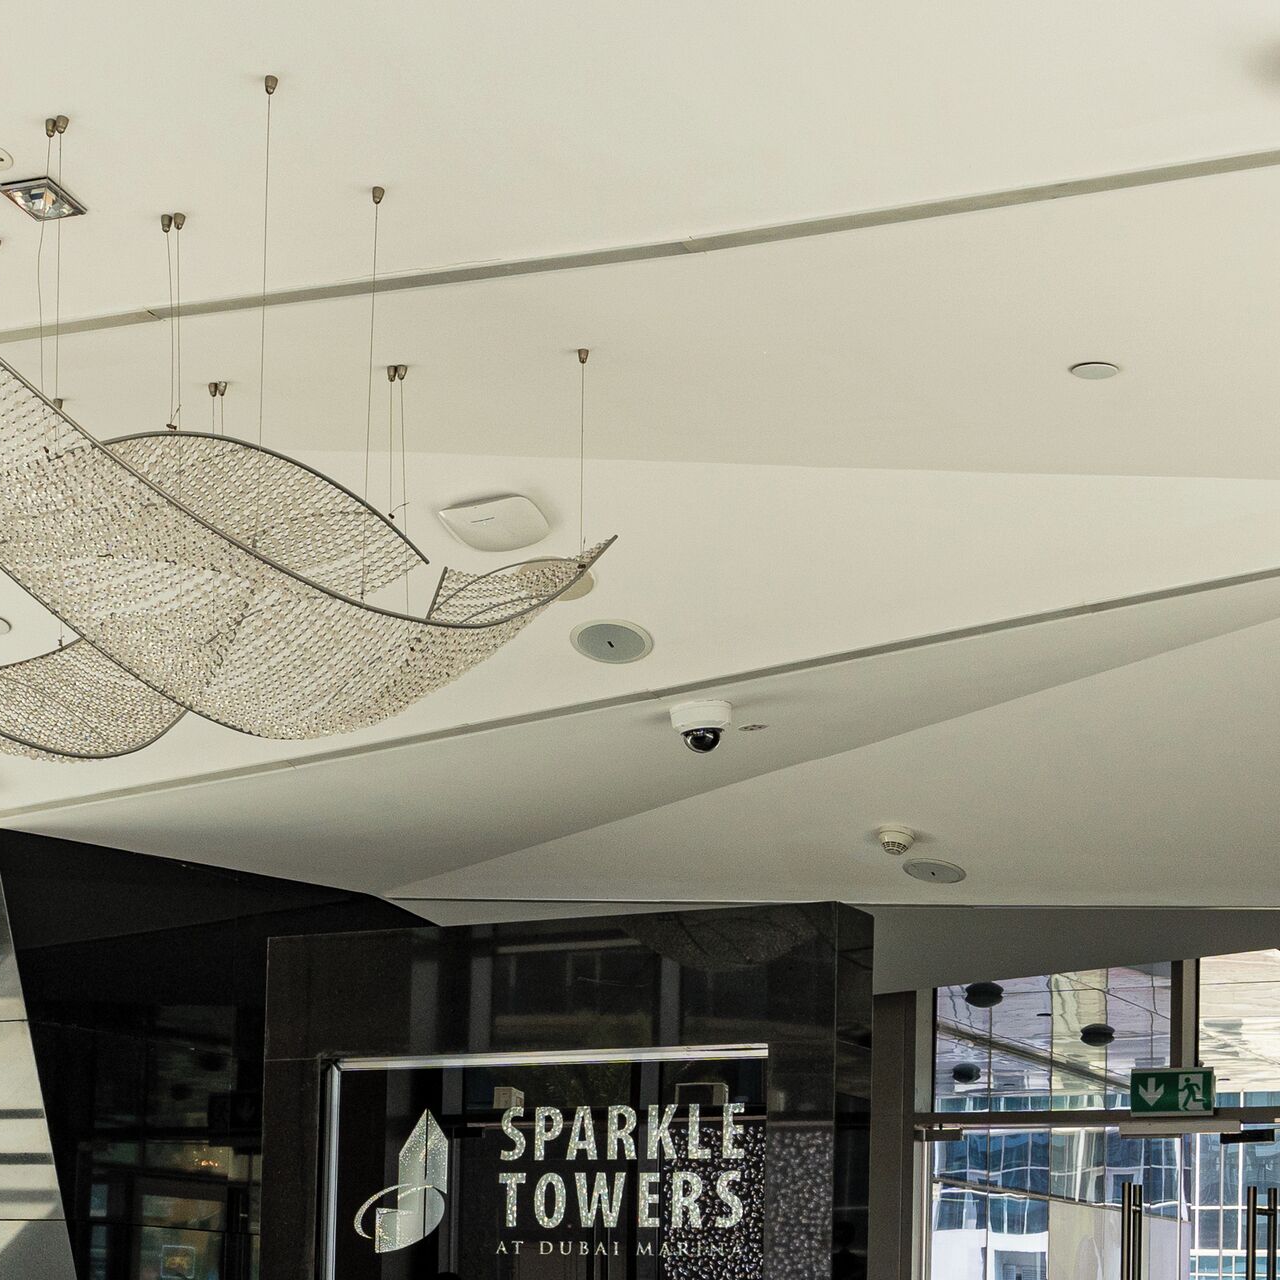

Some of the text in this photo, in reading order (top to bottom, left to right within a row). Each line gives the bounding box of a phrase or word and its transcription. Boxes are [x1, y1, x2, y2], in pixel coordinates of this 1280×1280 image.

[499, 1102, 746, 1161] SPARKLE
[498, 1170, 744, 1229] TOWERS
[495, 1240, 742, 1257] AT DUBAI MARINA
